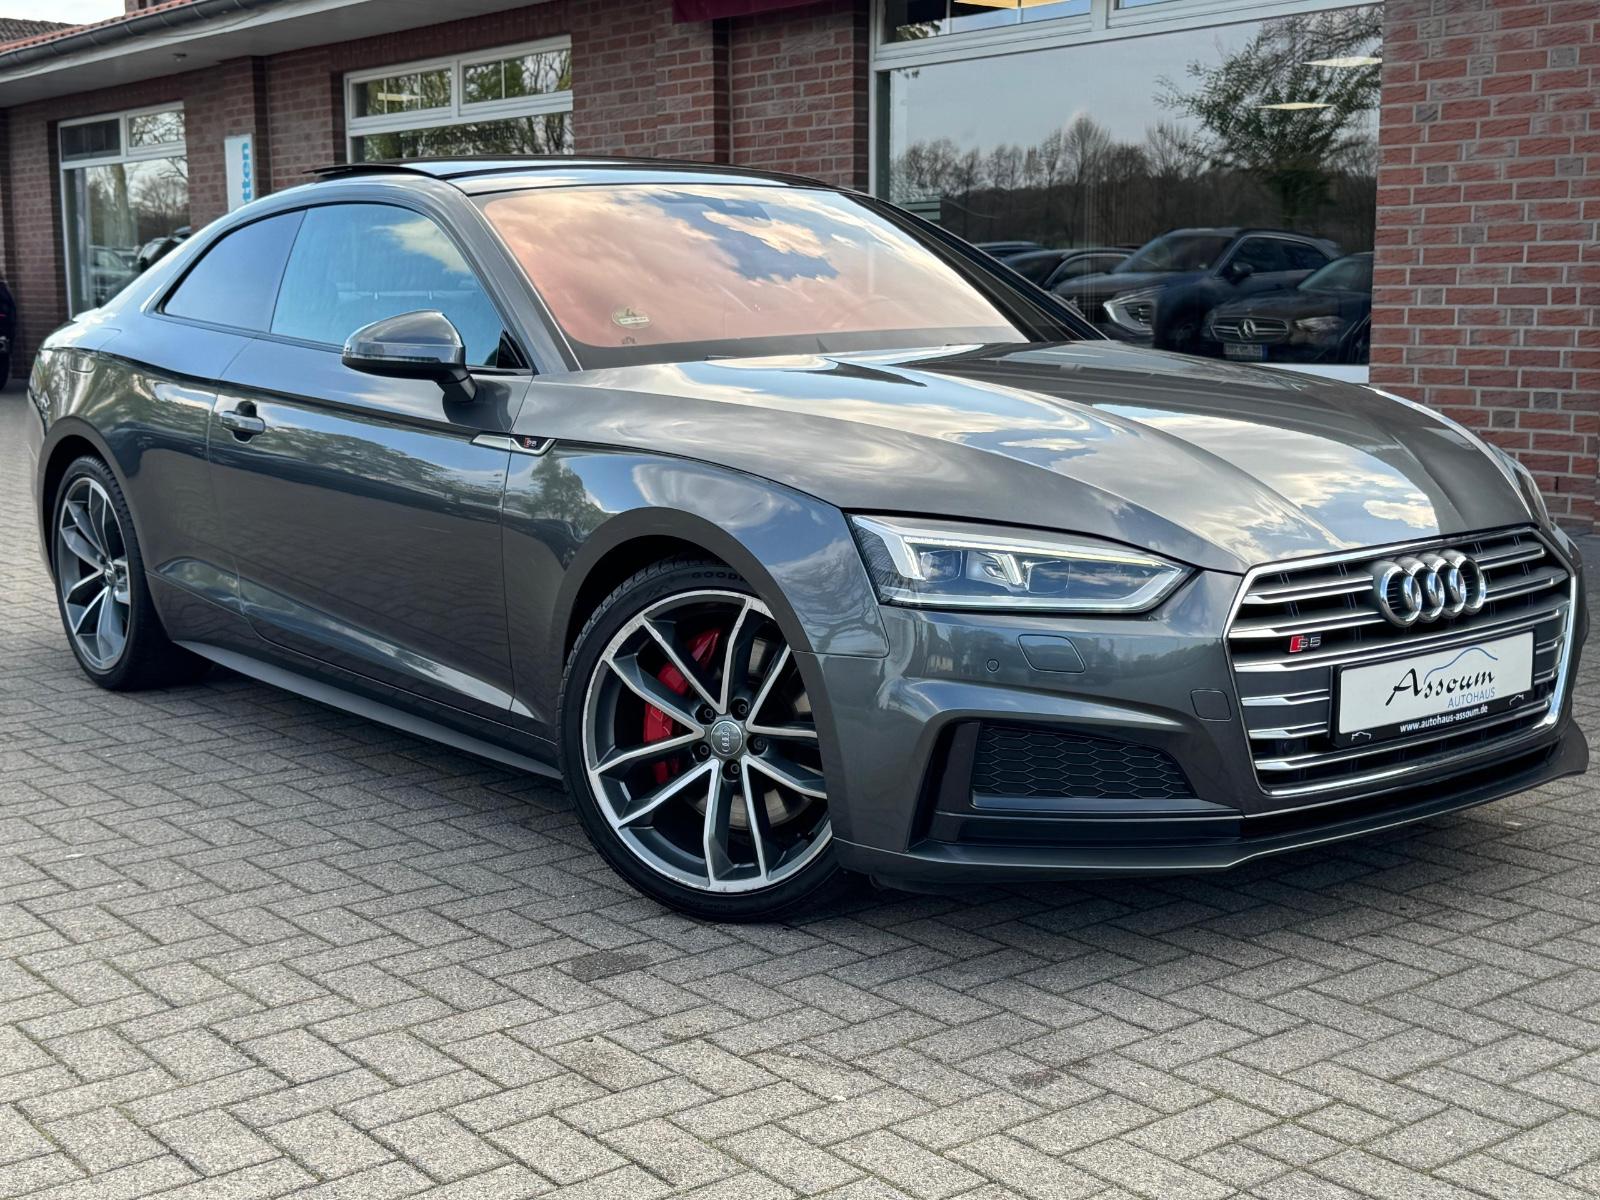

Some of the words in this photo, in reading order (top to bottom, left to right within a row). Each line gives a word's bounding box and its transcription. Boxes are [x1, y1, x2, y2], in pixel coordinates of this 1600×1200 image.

[1293, 636, 1321, 650] S5
[1385, 668, 1495, 706] Assoum
[1448, 687, 1496, 708] AUTOHAUS
[1400, 704, 1488, 733] www.autohaus-assoum.de
